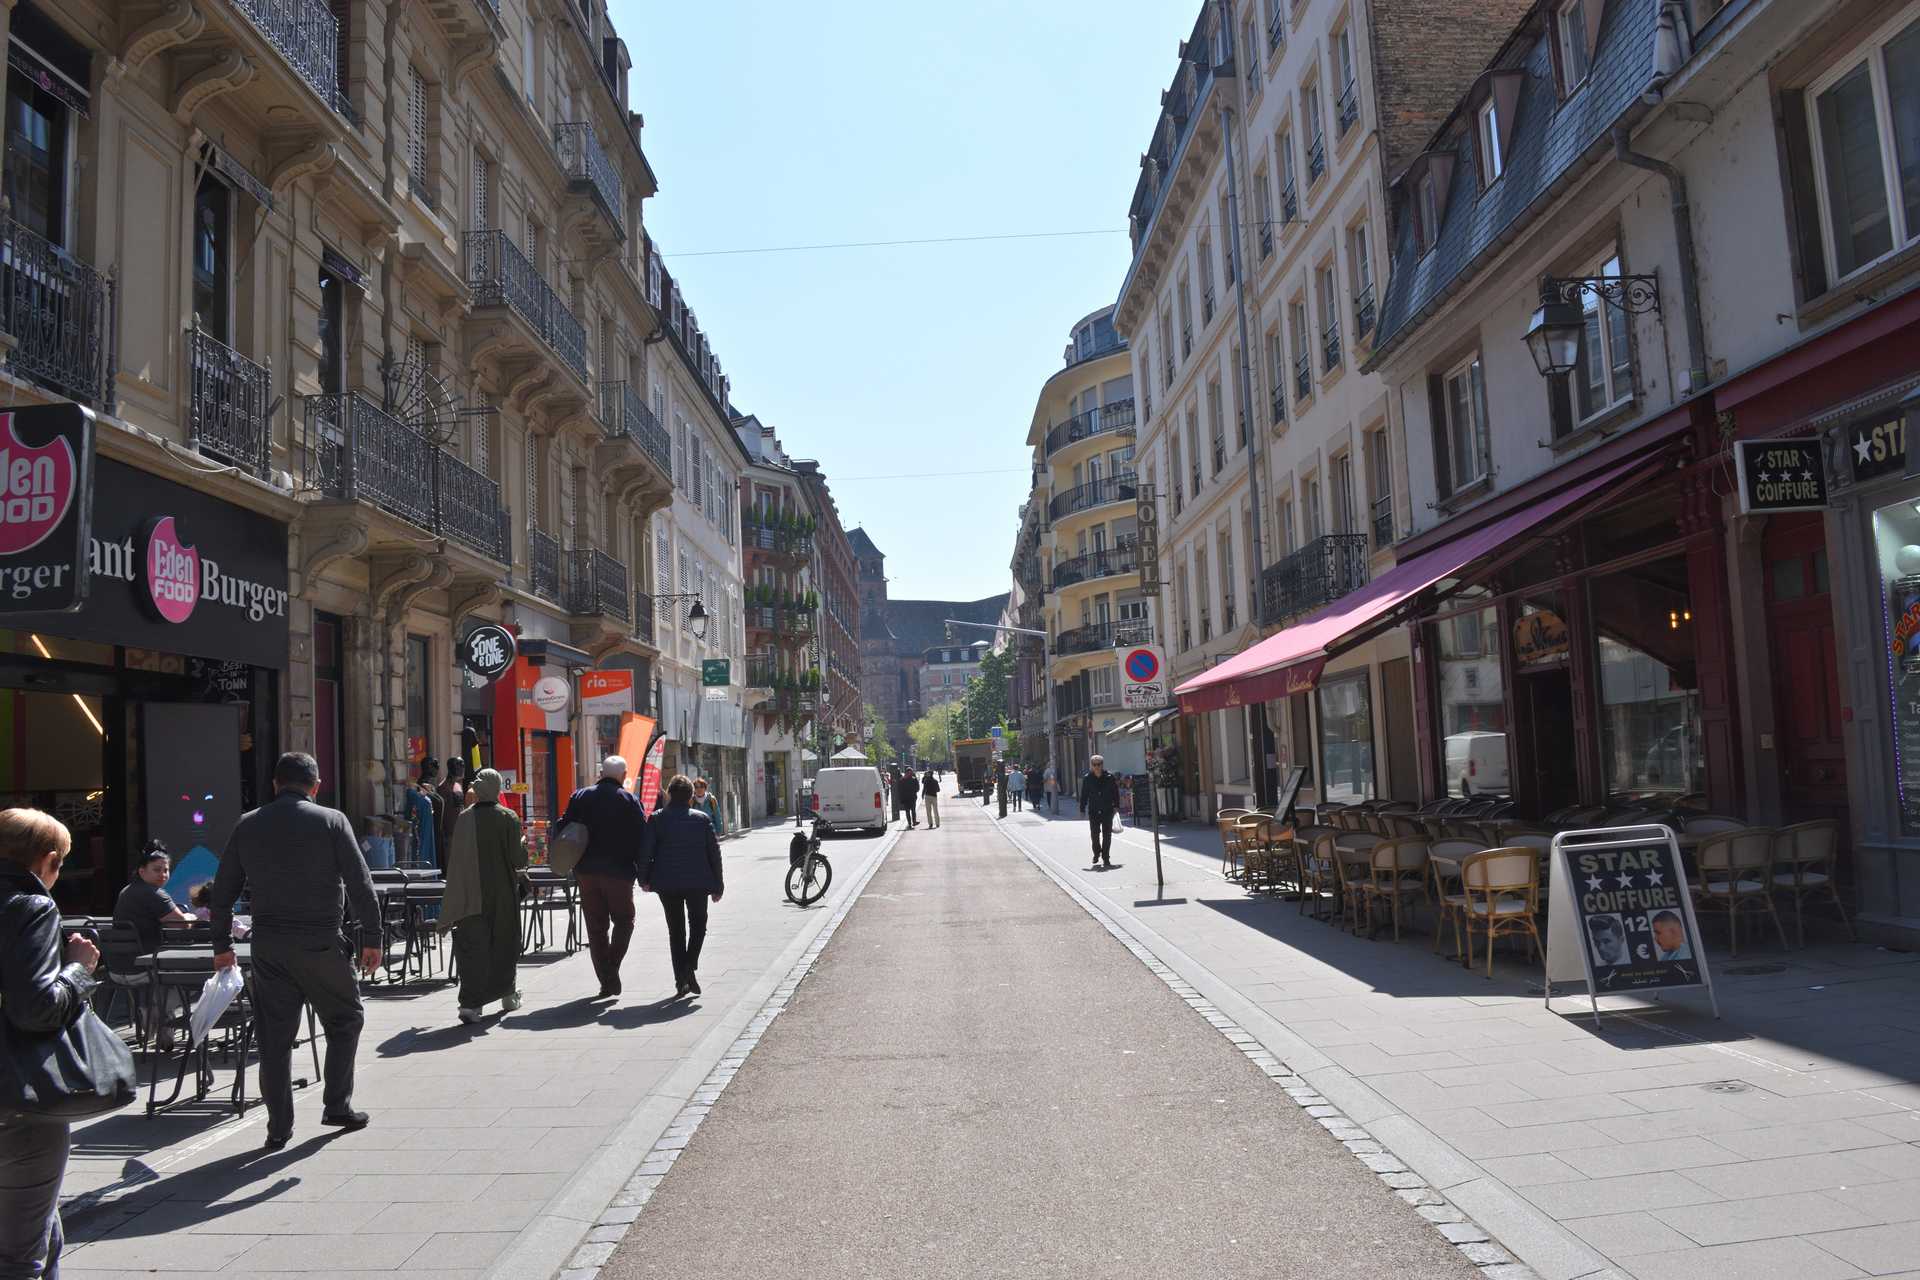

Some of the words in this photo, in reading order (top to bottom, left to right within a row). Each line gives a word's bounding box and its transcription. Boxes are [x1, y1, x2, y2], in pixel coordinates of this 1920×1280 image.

[1767, 450, 1800, 468] STAR
[1756, 480, 1819, 501] COIFFURE
[1138, 485, 1158, 583] HOTEL
[154, 538, 194, 582] Eden
[155, 579, 194, 603] FOOD
[200, 558, 288, 623] Burger
[478, 636, 500, 656] ONE
[485, 648, 505, 667] ONE
[217, 677, 248, 690] TOWN
[587, 674, 607, 688] ria
[1579, 849, 1663, 873] STAR
[1583, 886, 1678, 913] COIFFURE
[1625, 916, 1649, 932] 12
[1636, 943, 1650, 960] €
